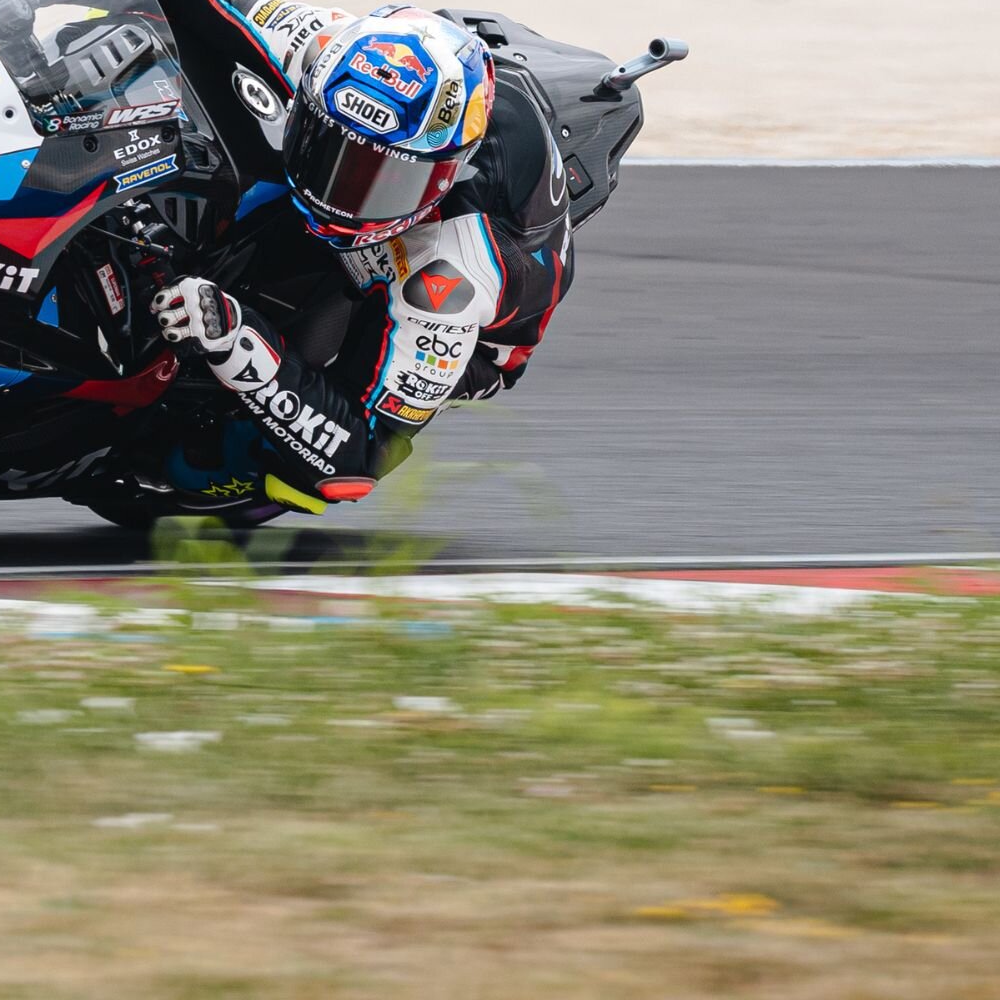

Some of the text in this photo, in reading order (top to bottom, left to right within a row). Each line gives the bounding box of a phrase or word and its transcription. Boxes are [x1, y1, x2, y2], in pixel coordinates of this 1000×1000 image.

[109, 101, 178, 125] WRS
[341, 91, 391, 128] SHOEI
[438, 81, 460, 125] Beta
[308, 102, 419, 164] GIVES YOU WINGS
[113, 134, 162, 160] EDOX
[121, 162, 172, 186] RAVENOL
[303, 188, 354, 219] PROMETEON
[415, 334, 463, 358] ebc
[406, 375, 450, 395] ROKiT
[414, 391, 433, 401] OFF
[262, 416, 336, 475] MOTORRAD
